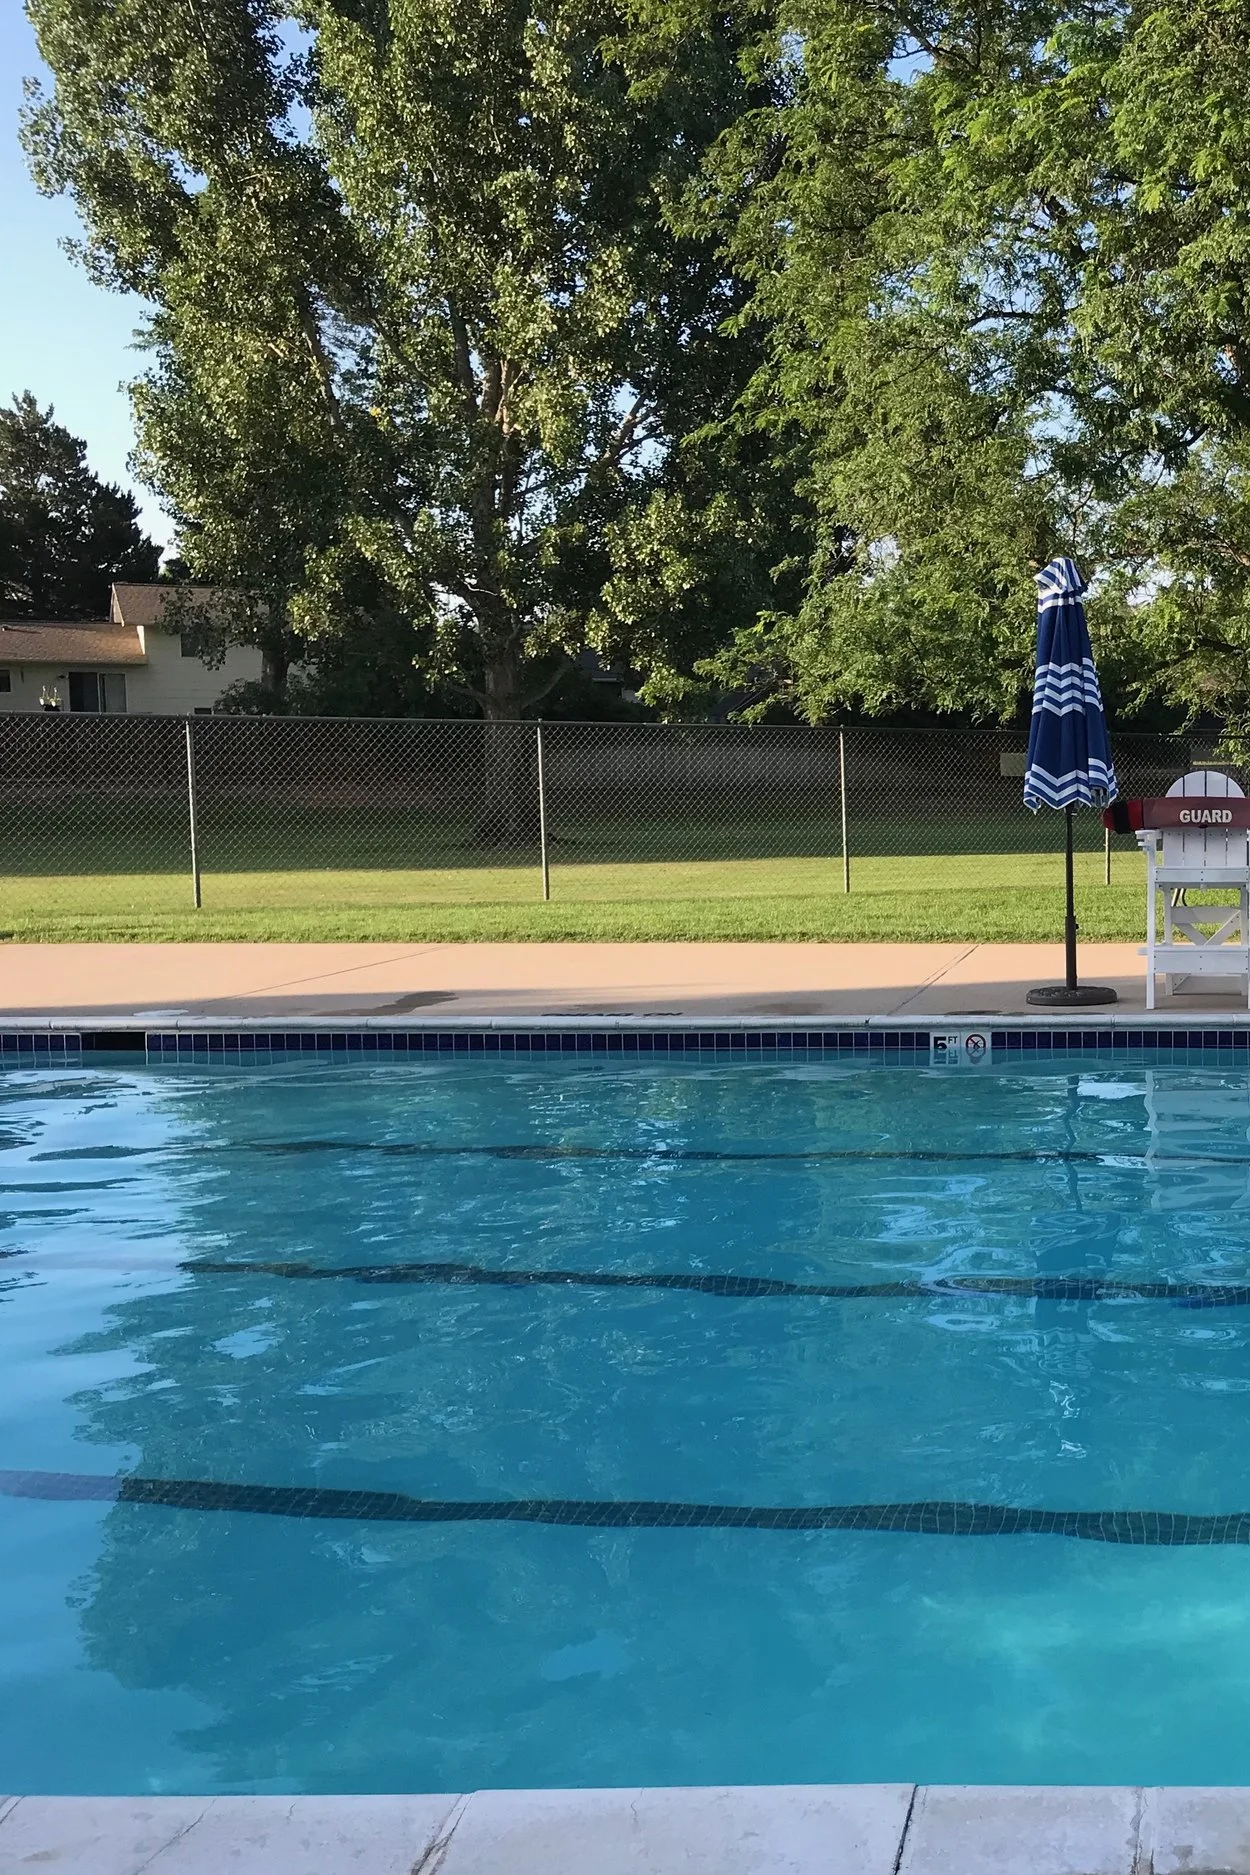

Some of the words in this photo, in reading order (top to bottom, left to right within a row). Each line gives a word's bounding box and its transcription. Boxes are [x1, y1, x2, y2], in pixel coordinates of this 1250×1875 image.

[1179, 809, 1233, 823] GUARD
[933, 1036, 947, 1050] 5
[948, 1036, 958, 1044] FT
